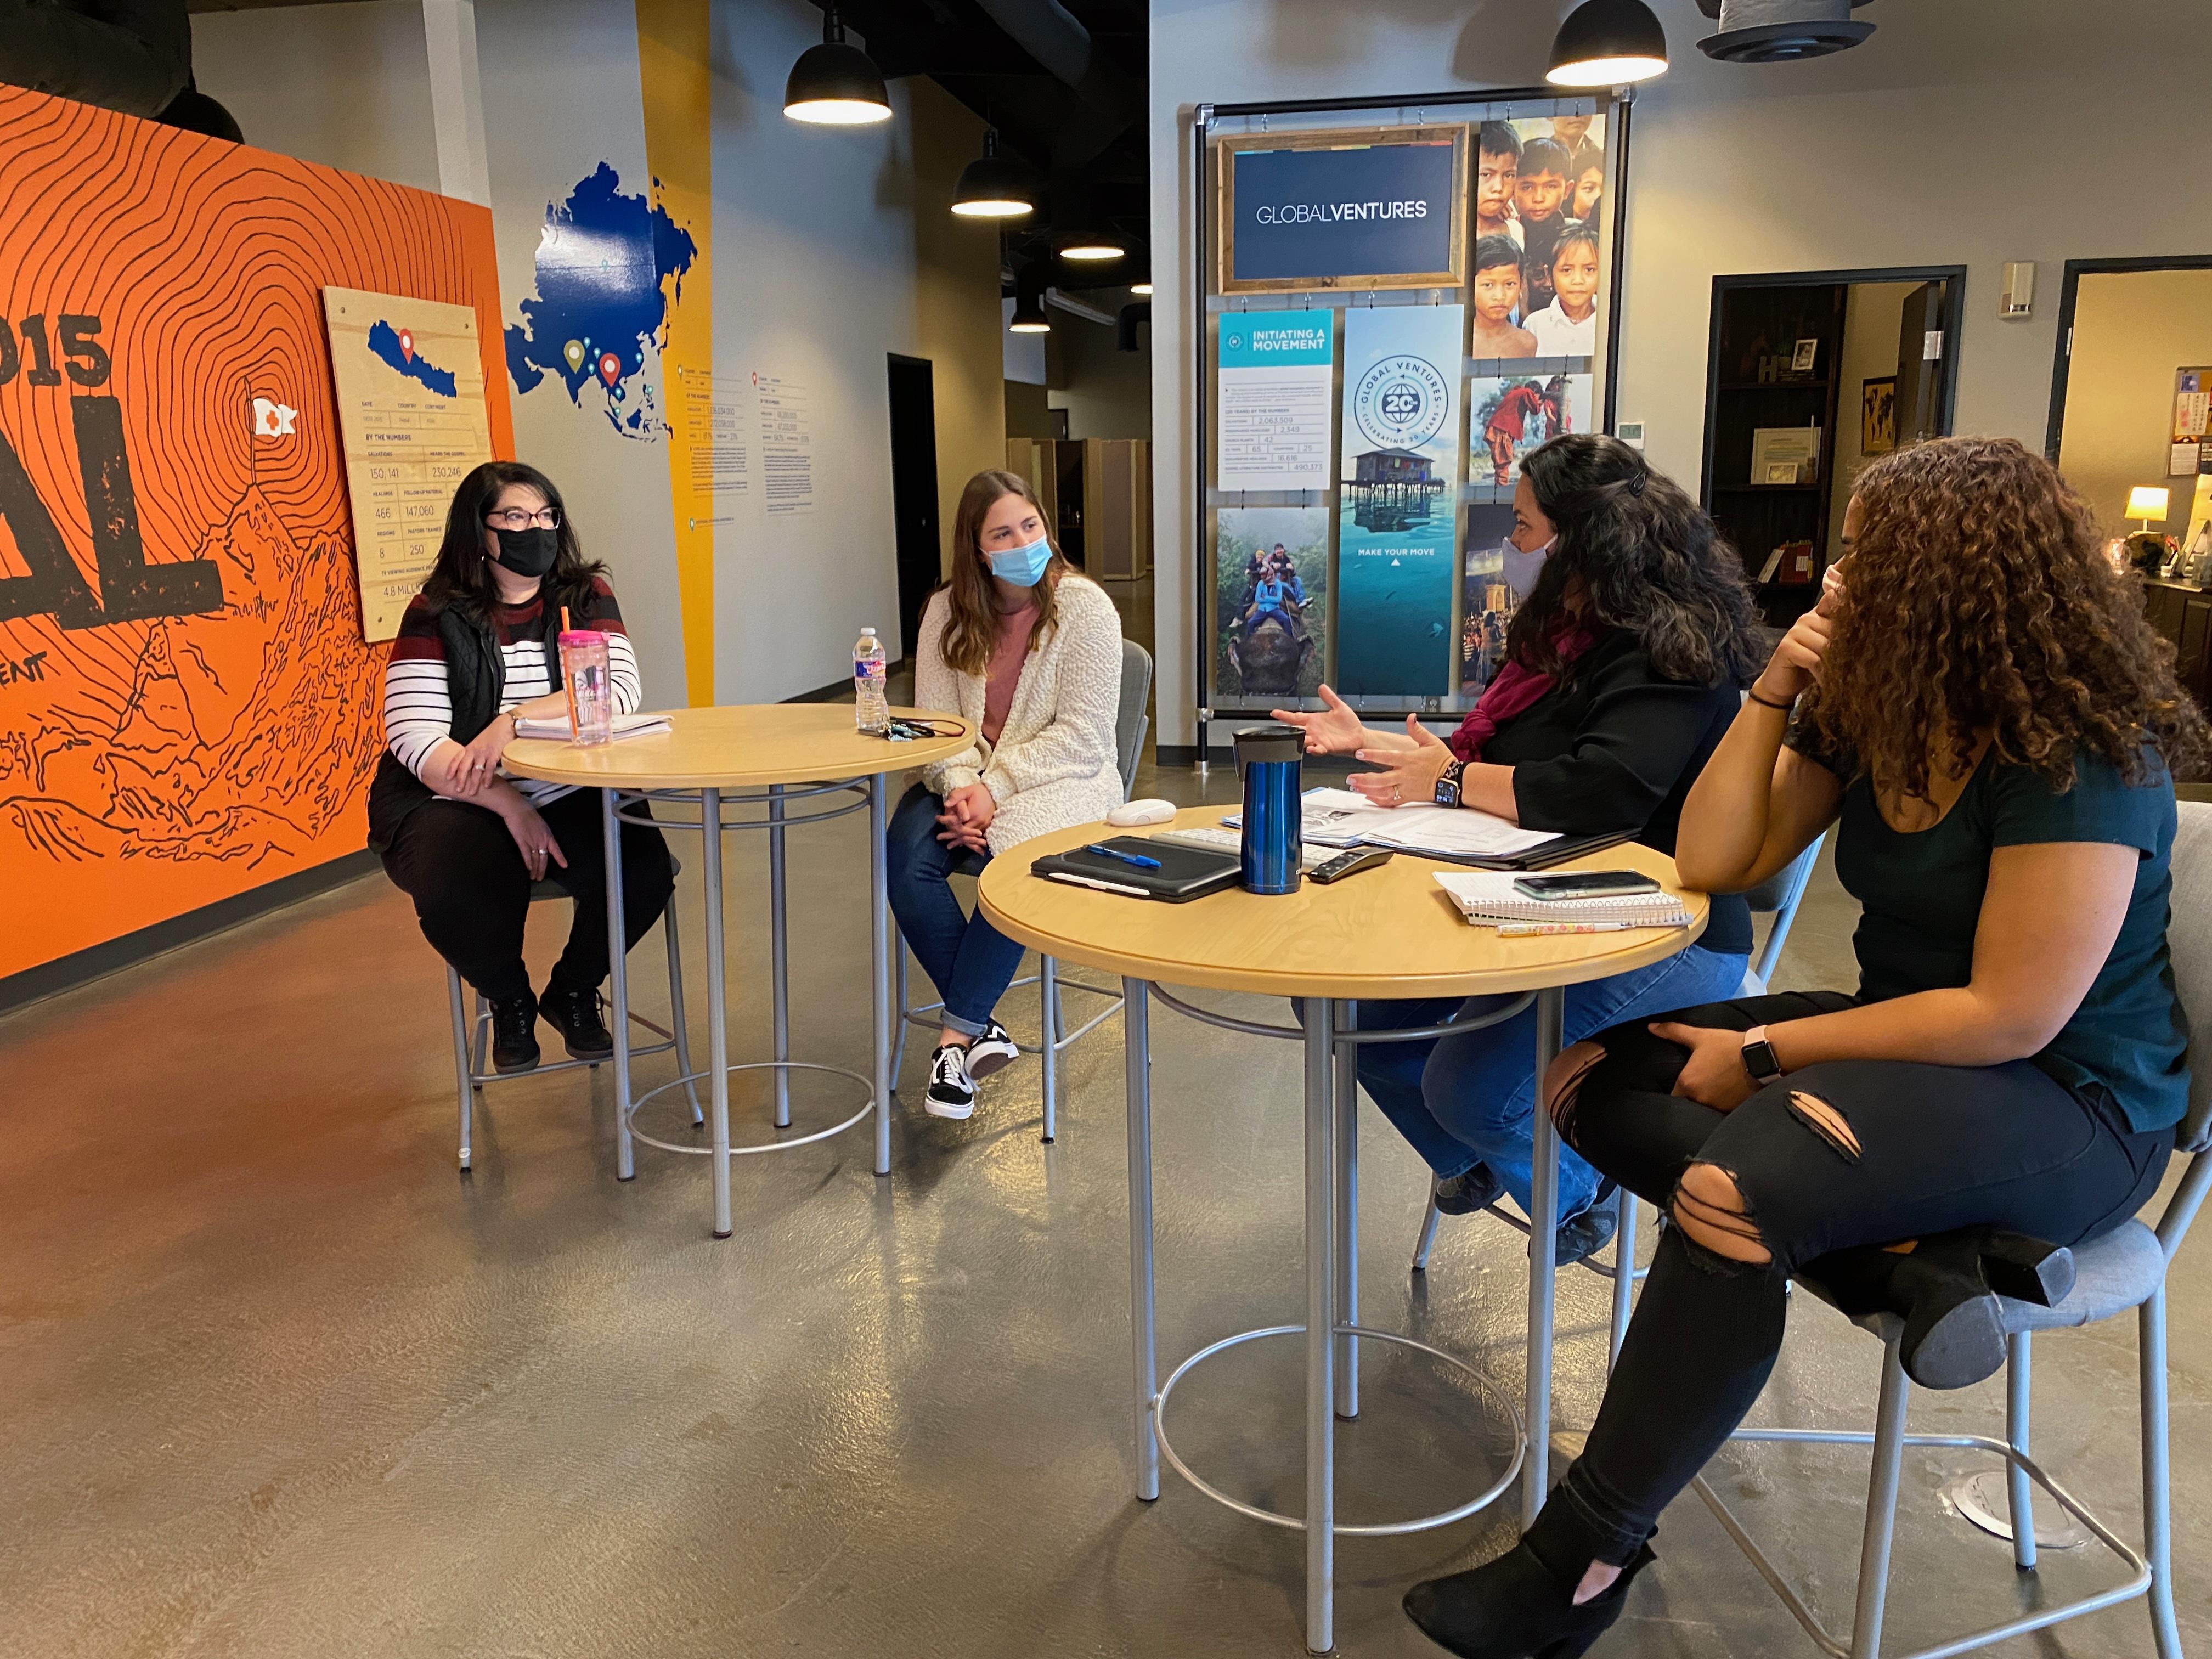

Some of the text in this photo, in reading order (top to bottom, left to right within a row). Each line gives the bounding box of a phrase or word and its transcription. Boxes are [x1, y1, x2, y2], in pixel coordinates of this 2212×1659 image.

[1256, 200, 1427, 224] GLOBALVENTURES
[1253, 329, 1325, 340] INITIATING A
[1253, 339, 1325, 351] MOVEMENT
[1361, 366, 1391, 404] GLOBAL
[1397, 362, 1441, 402] VENTURES
[1363, 413, 1404, 444] CELEBRATING
[1422, 412, 1438, 435] YEARS
[433, 467, 461, 478] 230,246
[375, 508, 391, 518] 466
[407, 505, 434, 518] 147,060
[380, 549, 385, 558] 8
[410, 545, 424, 555] 250
